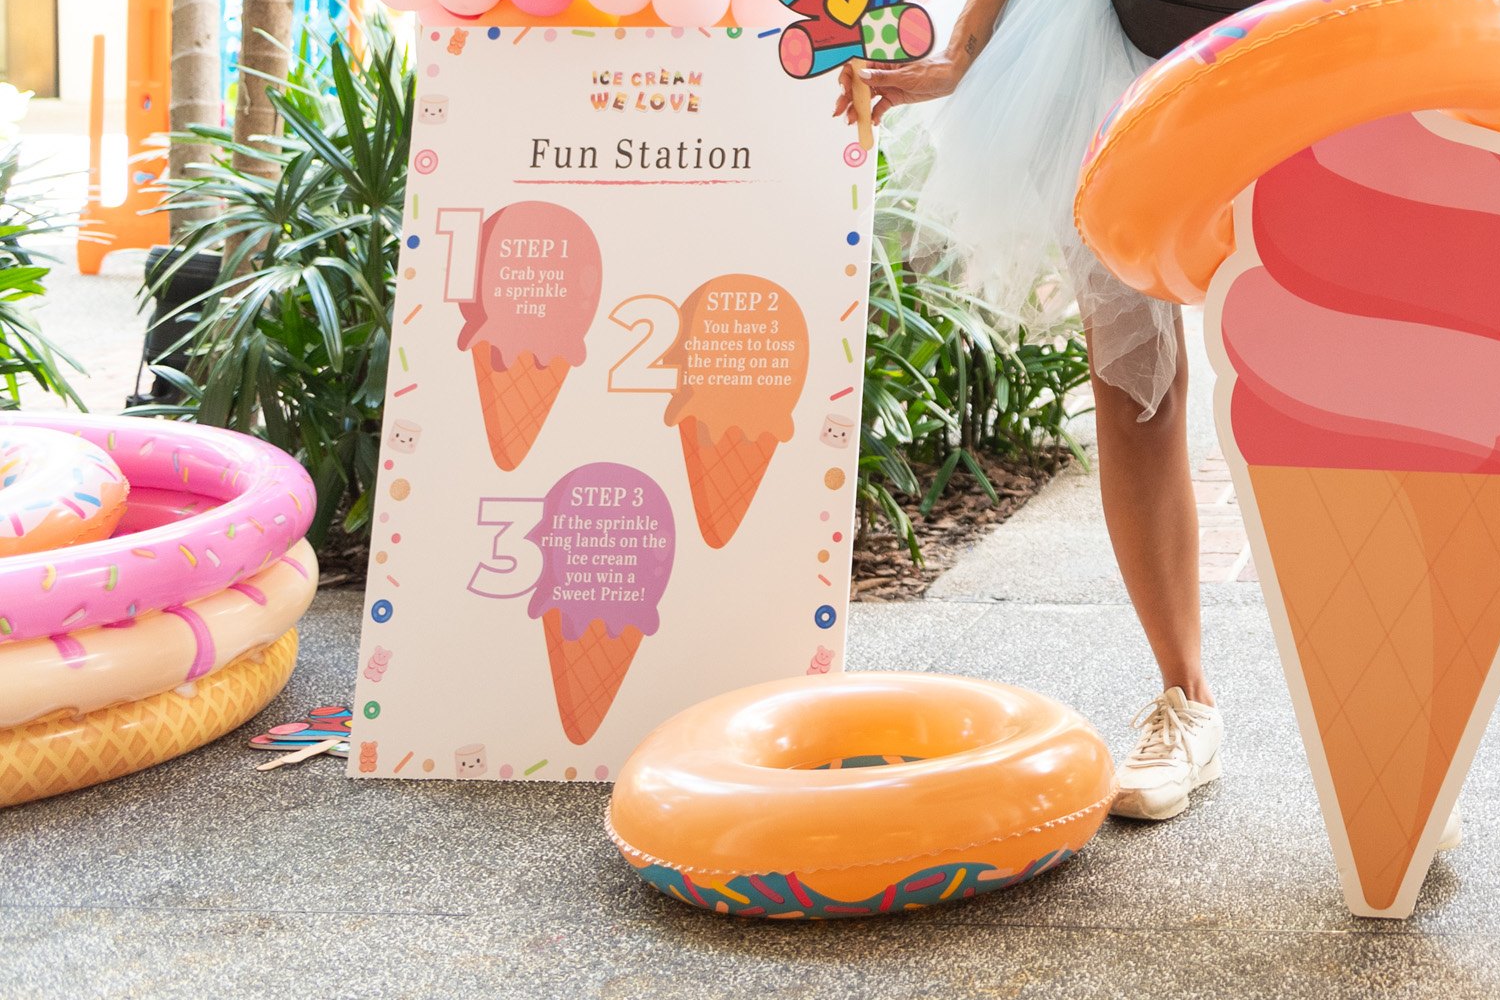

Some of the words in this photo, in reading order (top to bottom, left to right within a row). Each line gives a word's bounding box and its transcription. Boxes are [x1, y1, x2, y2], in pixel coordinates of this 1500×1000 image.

[591, 70, 624, 86] ICE
[630, 68, 704, 86] CREAM
[590, 91, 628, 112] WE
[634, 91, 701, 113] LOVE
[529, 138, 598, 169] Fun
[615, 138, 752, 170] Station
[435, 207, 485, 303] 1
[500, 238, 555, 259] STEP
[560, 239, 569, 258] 1
[500, 265, 535, 281] Grab
[538, 269, 565, 284] you
[494, 287, 502, 298] a
[506, 283, 568, 300] sprinkle
[515, 301, 547, 317] ring
[706, 292, 763, 312] STEP
[768, 292, 779, 311] 2
[703, 319, 729, 334] You
[733, 319, 767, 334] have
[770, 319, 779, 334] 3
[607, 294, 682, 393] 2
[684, 336, 743, 351] chances
[747, 337, 762, 351] to
[766, 337, 795, 352] toss
[687, 354, 712, 369] the
[715, 354, 746, 371] ring
[750, 357, 767, 369] on
[772, 357, 789, 369] an
[682, 371, 704, 386] ice
[708, 374, 753, 386] cream
[756, 374, 792, 386] cone
[570, 486, 627, 507] STEP
[632, 487, 644, 507] 3
[552, 515, 568, 530] If
[568, 515, 592, 530] the
[595, 515, 659, 533] sprinkle
[466, 496, 546, 600] 3
[541, 534, 572, 551] ring
[575, 534, 616, 548] lands
[620, 536, 639, 548] on
[642, 534, 667, 549] the
[566, 551, 588, 565] ice
[592, 553, 638, 566] cream
[565, 571, 592, 585] you
[596, 569, 623, 583] win
[627, 572, 636, 583] a
[552, 586, 596, 601] Sweet
[600, 587, 646, 602] Prize!
